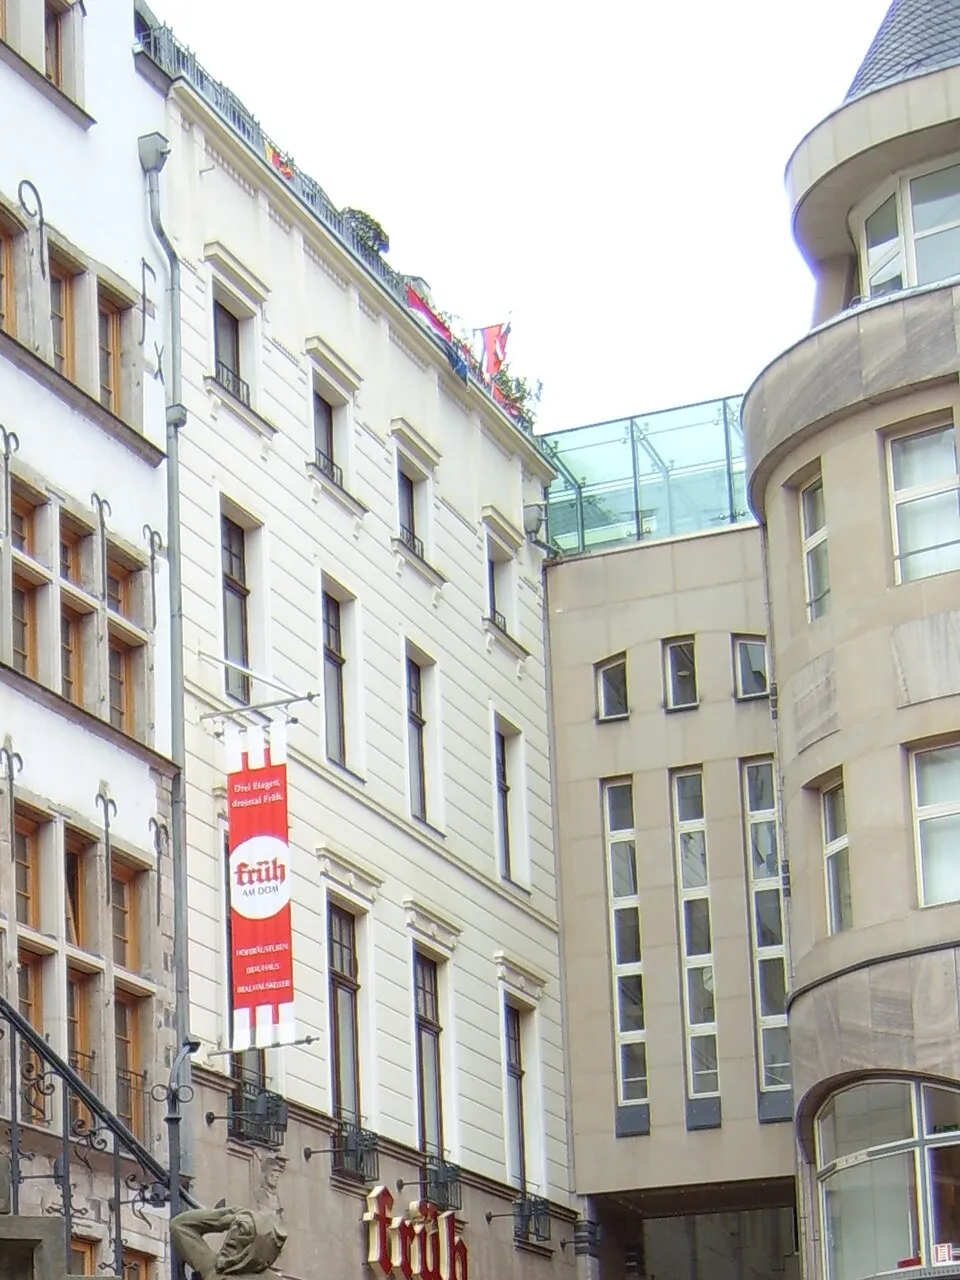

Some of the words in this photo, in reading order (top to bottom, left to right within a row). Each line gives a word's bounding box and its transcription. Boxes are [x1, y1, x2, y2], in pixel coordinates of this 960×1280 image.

[234, 782, 251, 793] Drei
[234, 857, 286, 887] früh
[242, 888, 256, 897] AM
[258, 885, 279, 895] DOM
